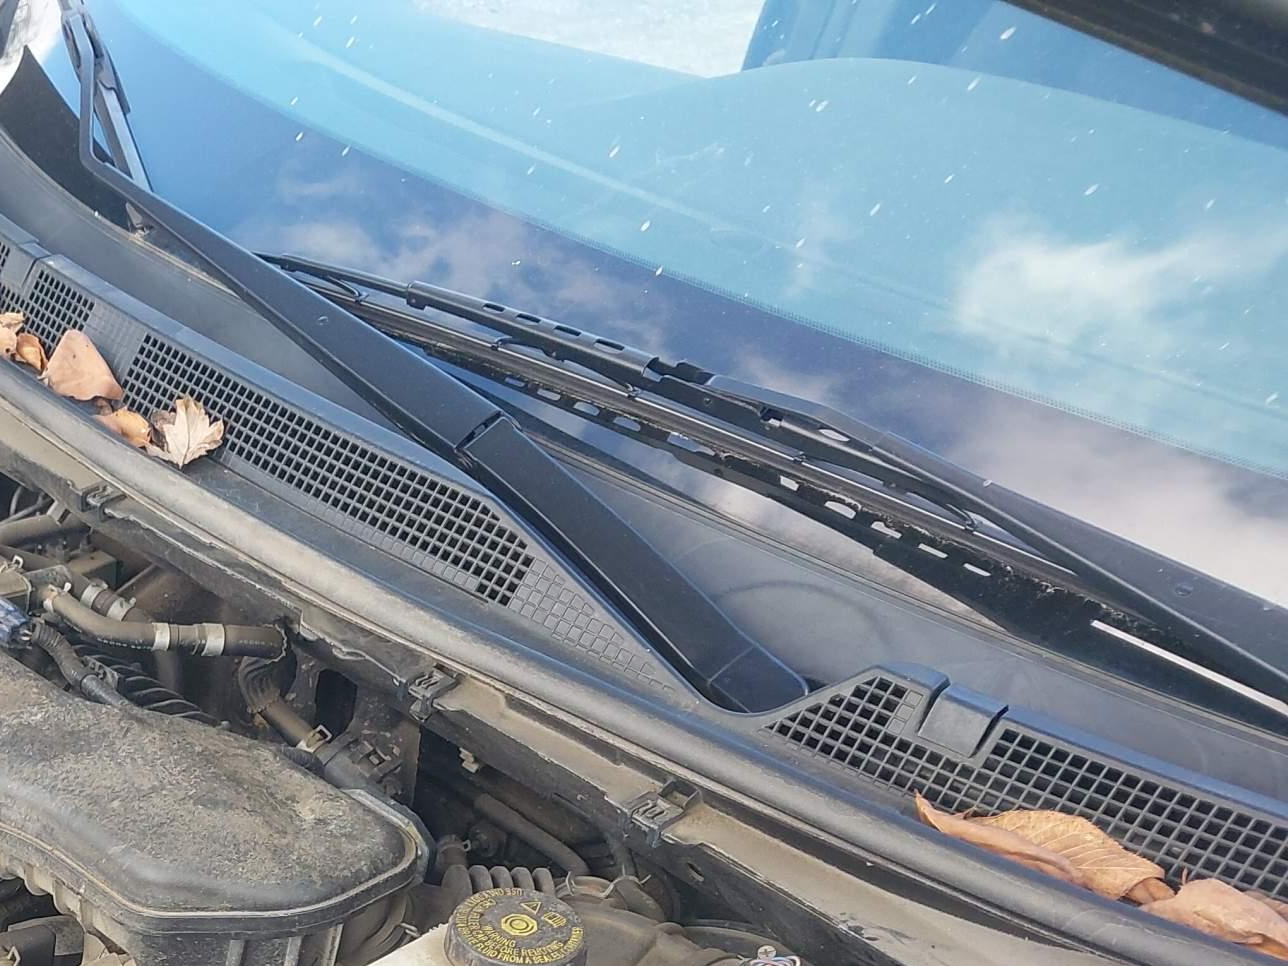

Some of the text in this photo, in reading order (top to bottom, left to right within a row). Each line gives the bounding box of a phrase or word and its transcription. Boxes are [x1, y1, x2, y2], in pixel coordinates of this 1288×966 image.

[470, 929, 491, 942] CAP
[482, 938, 520, 956] BEFORE
[480, 925, 516, 948] WARNING
[471, 942, 499, 959] FLUID
[495, 952, 524, 964] FROM
[522, 956, 533, 964] A
